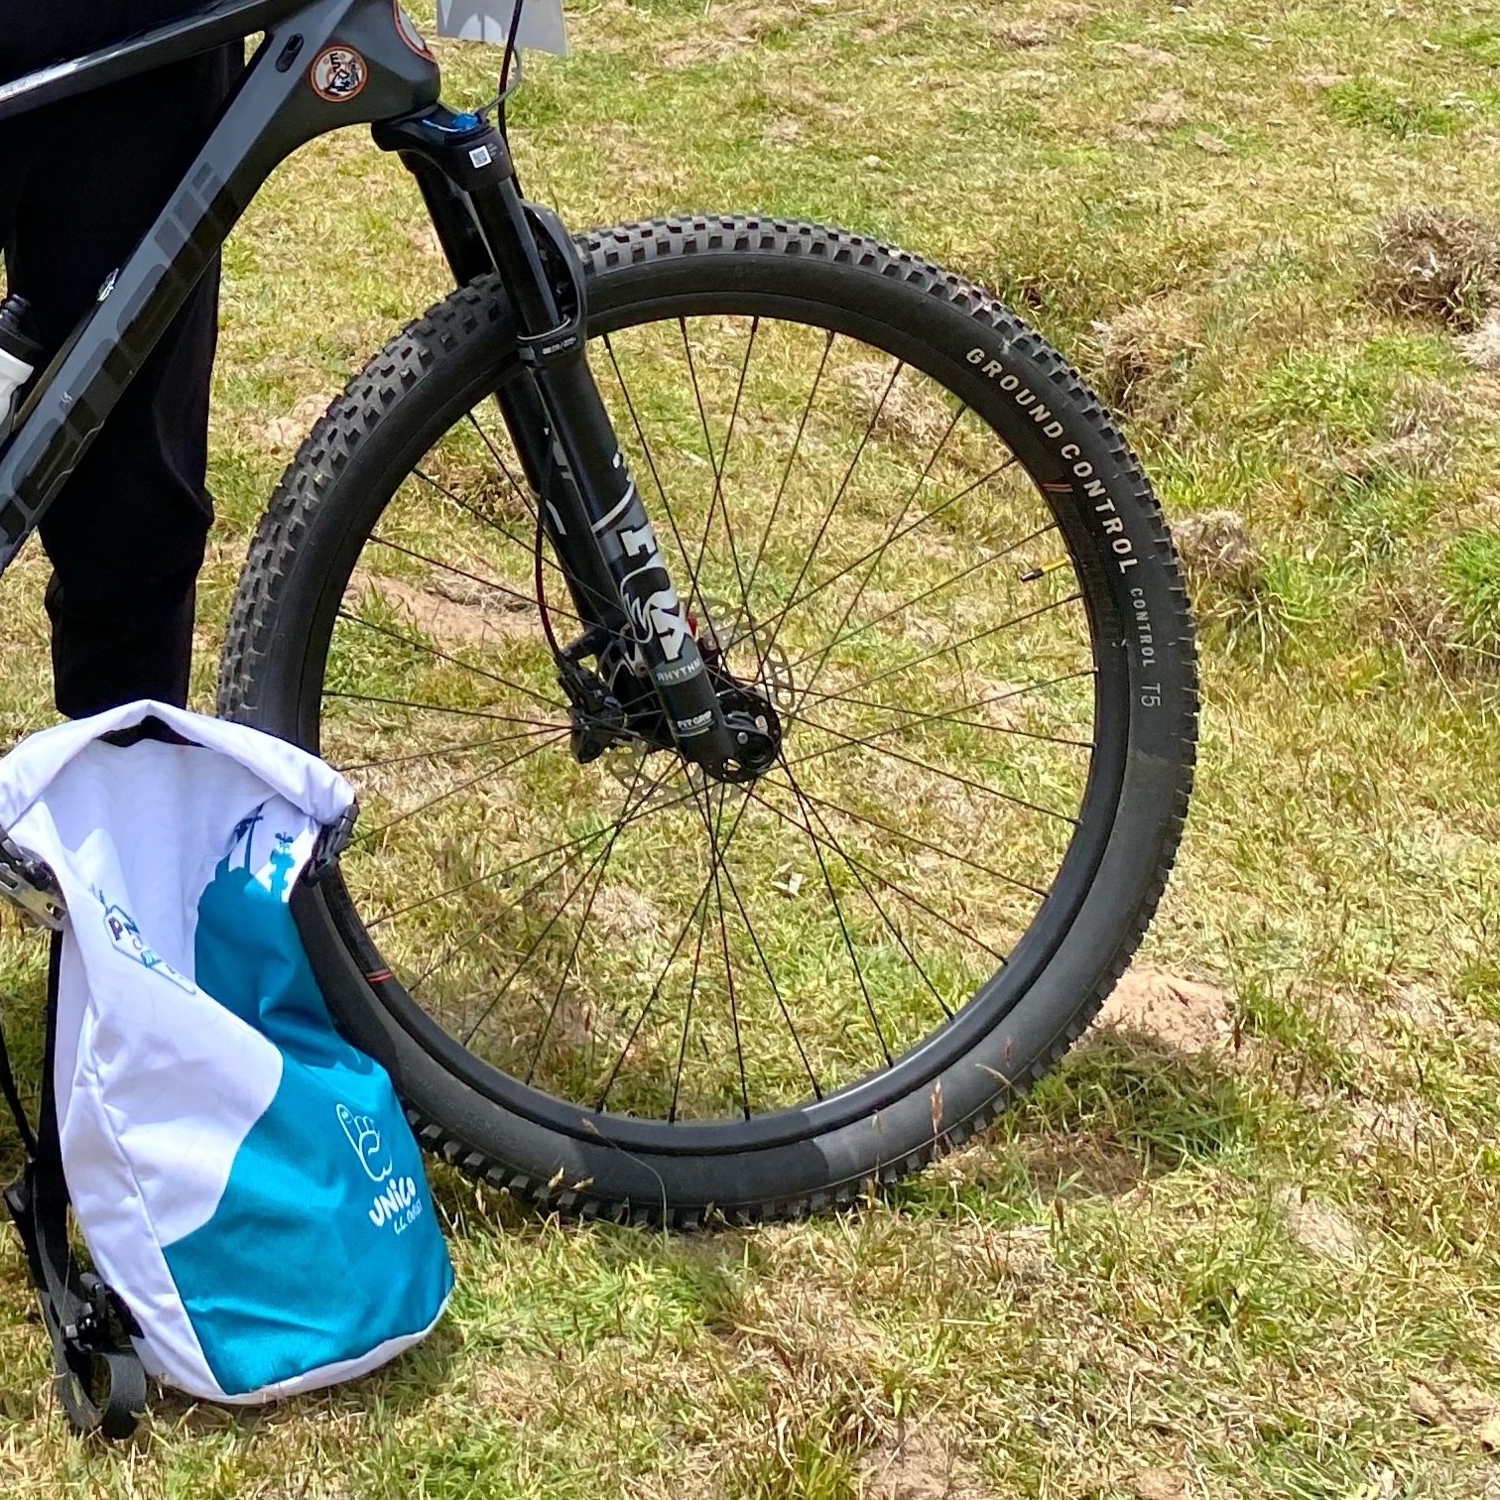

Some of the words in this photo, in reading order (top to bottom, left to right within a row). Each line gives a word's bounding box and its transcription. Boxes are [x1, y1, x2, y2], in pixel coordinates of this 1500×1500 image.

[966, 348, 1064, 440] GROUND
[1060, 443, 1139, 574] CONTROL
[1130, 587, 1156, 668] CONTROL
[656, 658, 701, 682] RHYTHM
[1140, 682, 1162, 708] T5
